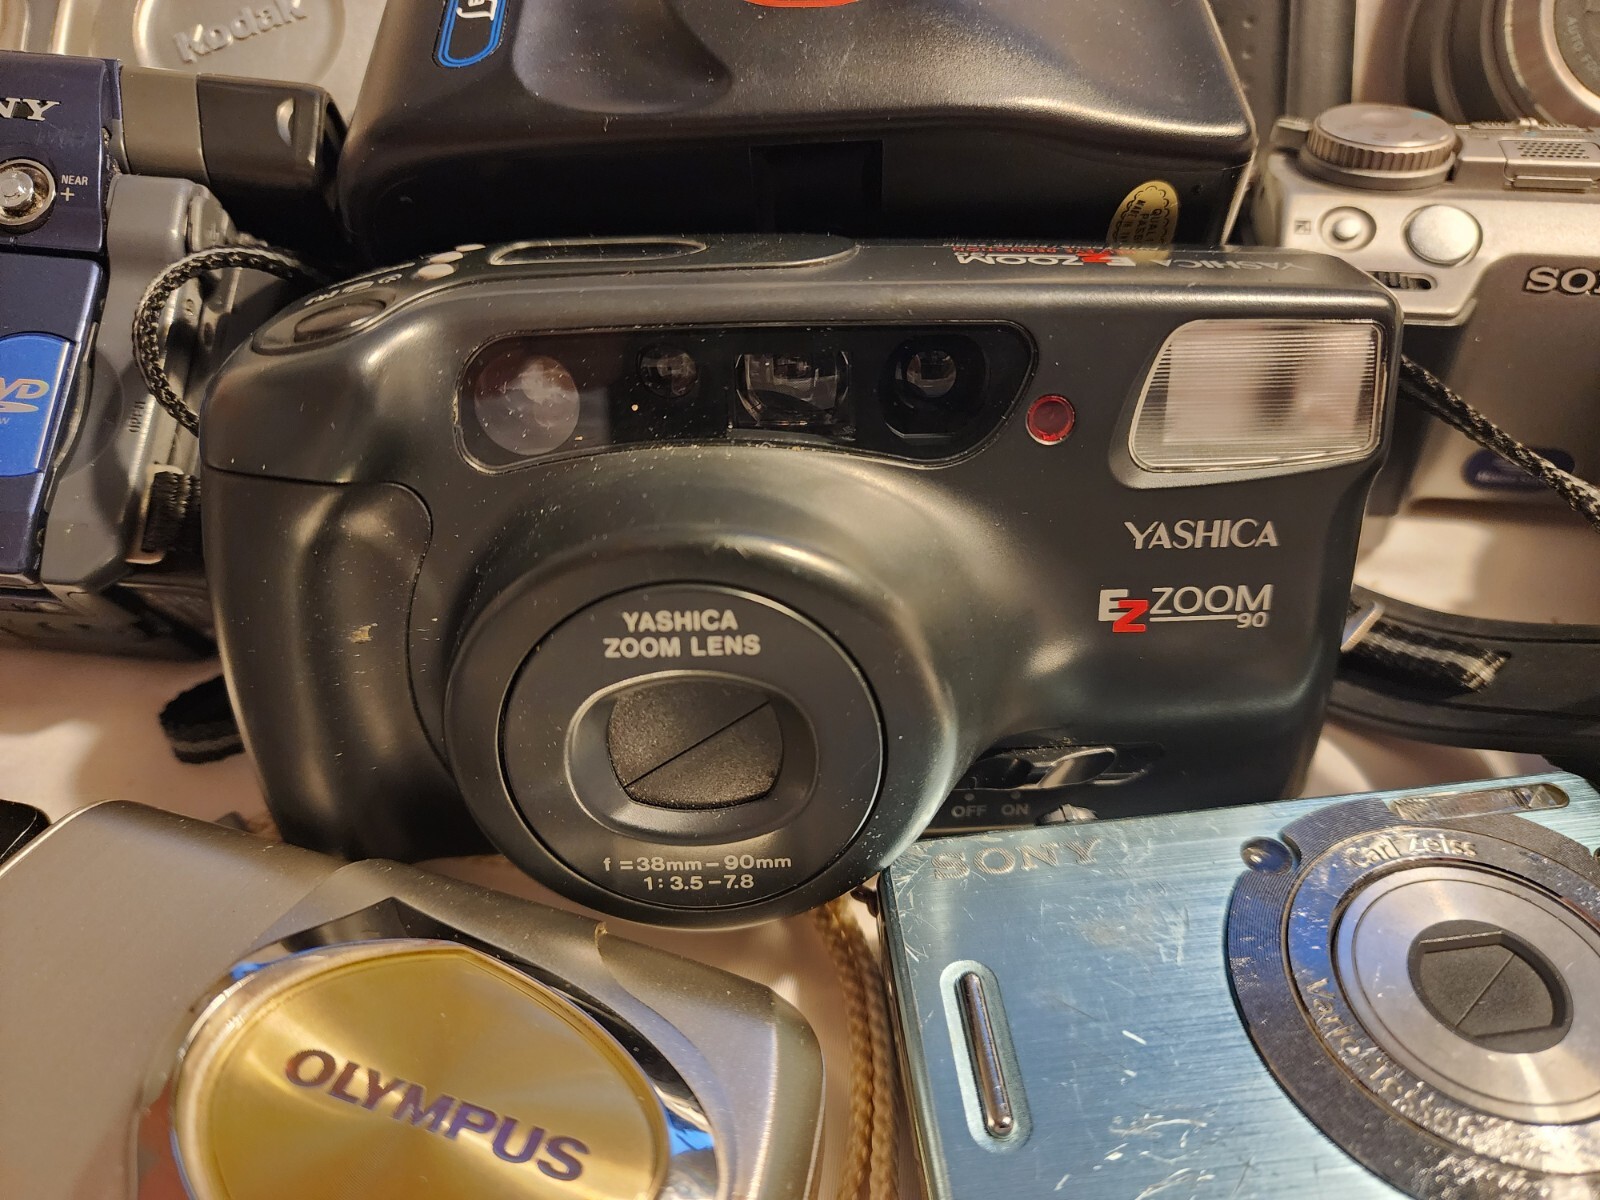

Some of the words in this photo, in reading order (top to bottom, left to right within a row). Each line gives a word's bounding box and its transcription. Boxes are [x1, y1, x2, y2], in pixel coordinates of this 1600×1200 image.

[173, 0, 307, 64] Kodak
[61, 174, 88, 186] NEAR
[1150, 258, 1314, 271] YASHICA
[1525, 266, 1600, 294] SO
[128, 400, 146, 433] OPEN
[1124, 518, 1280, 550] YASHICA
[621, 608, 738, 633] YASHICA
[1098, 588, 1149, 633] EZ
[1150, 584, 1274, 615] ZOOM
[1236, 611, 1268, 629] 90
[602, 636, 681, 658] ZOOM
[690, 634, 761, 656] LENS
[951, 804, 988, 818] OFF
[1001, 803, 1029, 815] ON
[931, 837, 1101, 880] SONY
[1344, 834, 1401, 868] Carl
[1406, 833, 1478, 857] Zeiss
[284, 1048, 591, 1182] OLYMPUS
